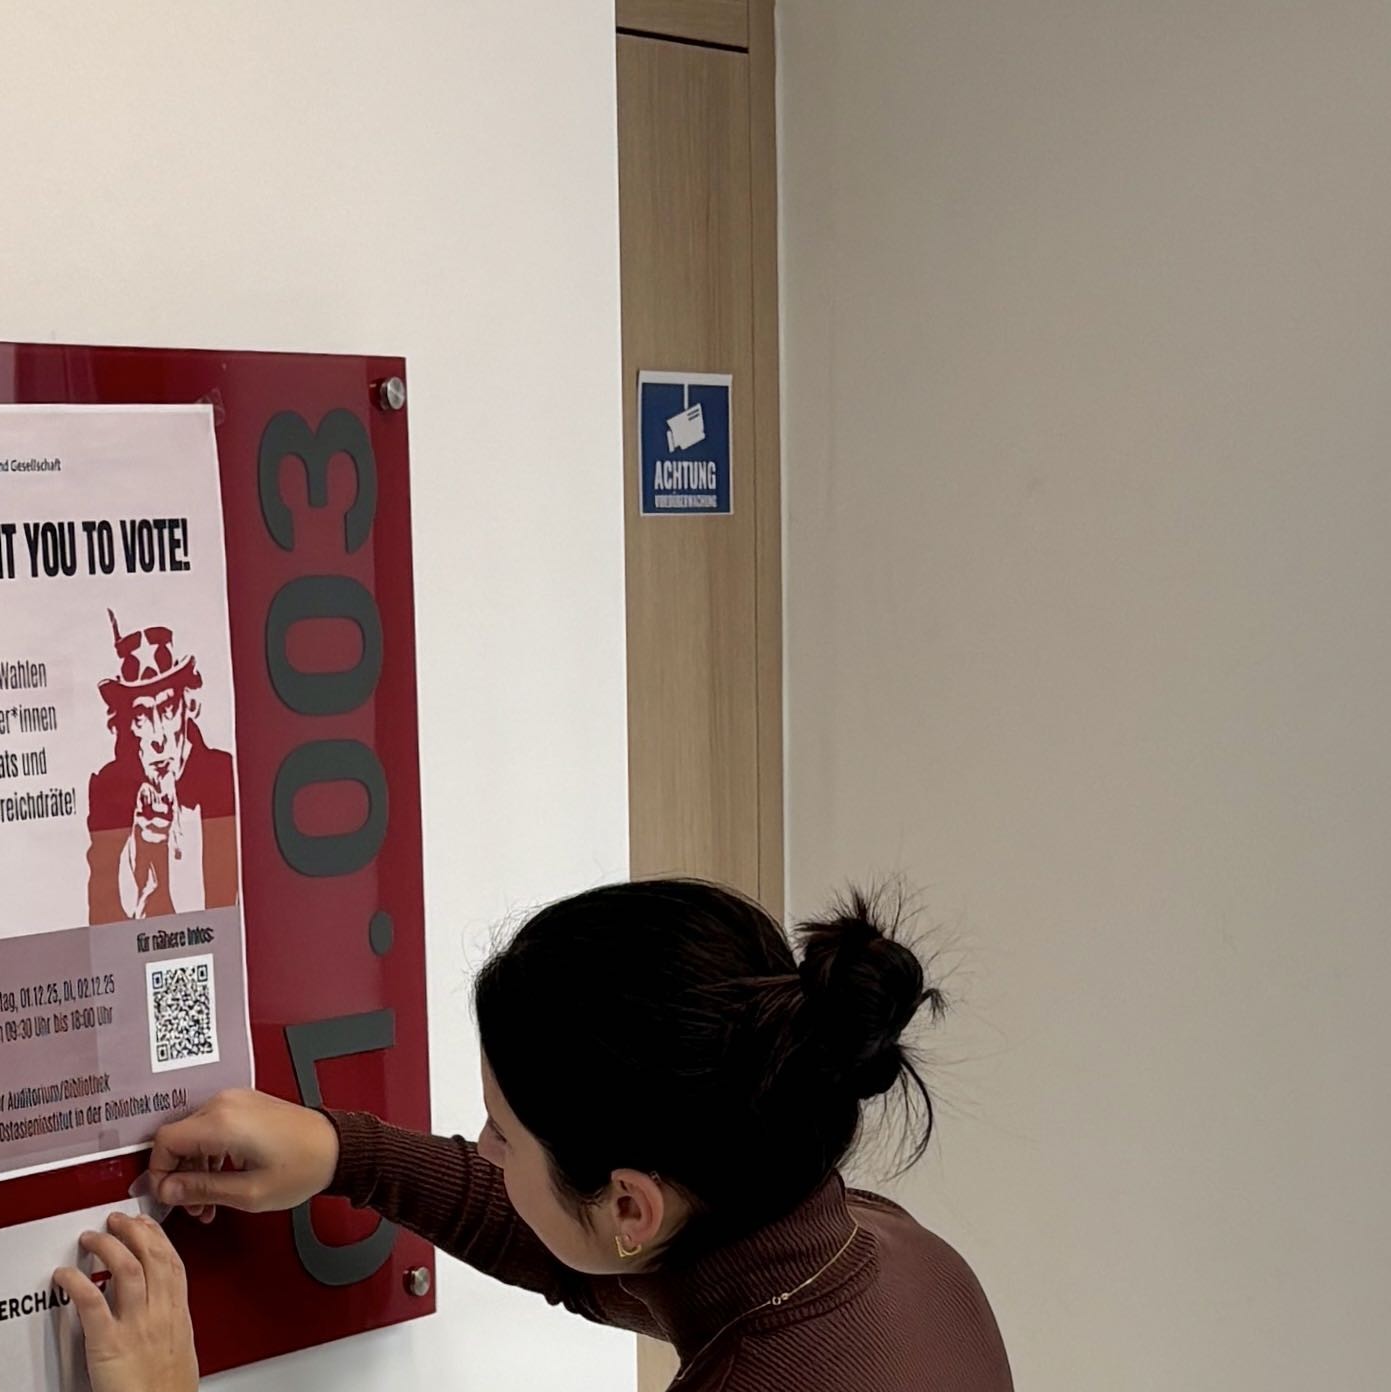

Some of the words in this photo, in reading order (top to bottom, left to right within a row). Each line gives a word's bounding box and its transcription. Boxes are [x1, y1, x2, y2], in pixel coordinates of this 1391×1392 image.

[11, 458, 61, 472] Gesellschaft
[654, 461, 716, 490] ACHTUNG
[23, 521, 77, 577] YOU
[82, 520, 115, 575] TO
[120, 518, 191, 573] VOTE!
[22, 747, 47, 776] und
[137, 932, 150, 953] für
[152, 929, 186, 951] nähere
[20, 983, 62, 1008] 01.12.25,
[77, 974, 115, 999] 02.12.25
[34, 1014, 50, 1037] Uhr
[53, 1012, 68, 1034] bis
[97, 1006, 113, 1026] Uhr
[8, 1073, 111, 1110] Auditorium/Bibliothek
[0, 1110, 73, 1142] Ostasieninstitut
[75, 1108, 84, 1127] in
[87, 1105, 102, 1123] der
[105, 1094, 151, 1121] Bibliothek
[153, 1092, 170, 1111] des
